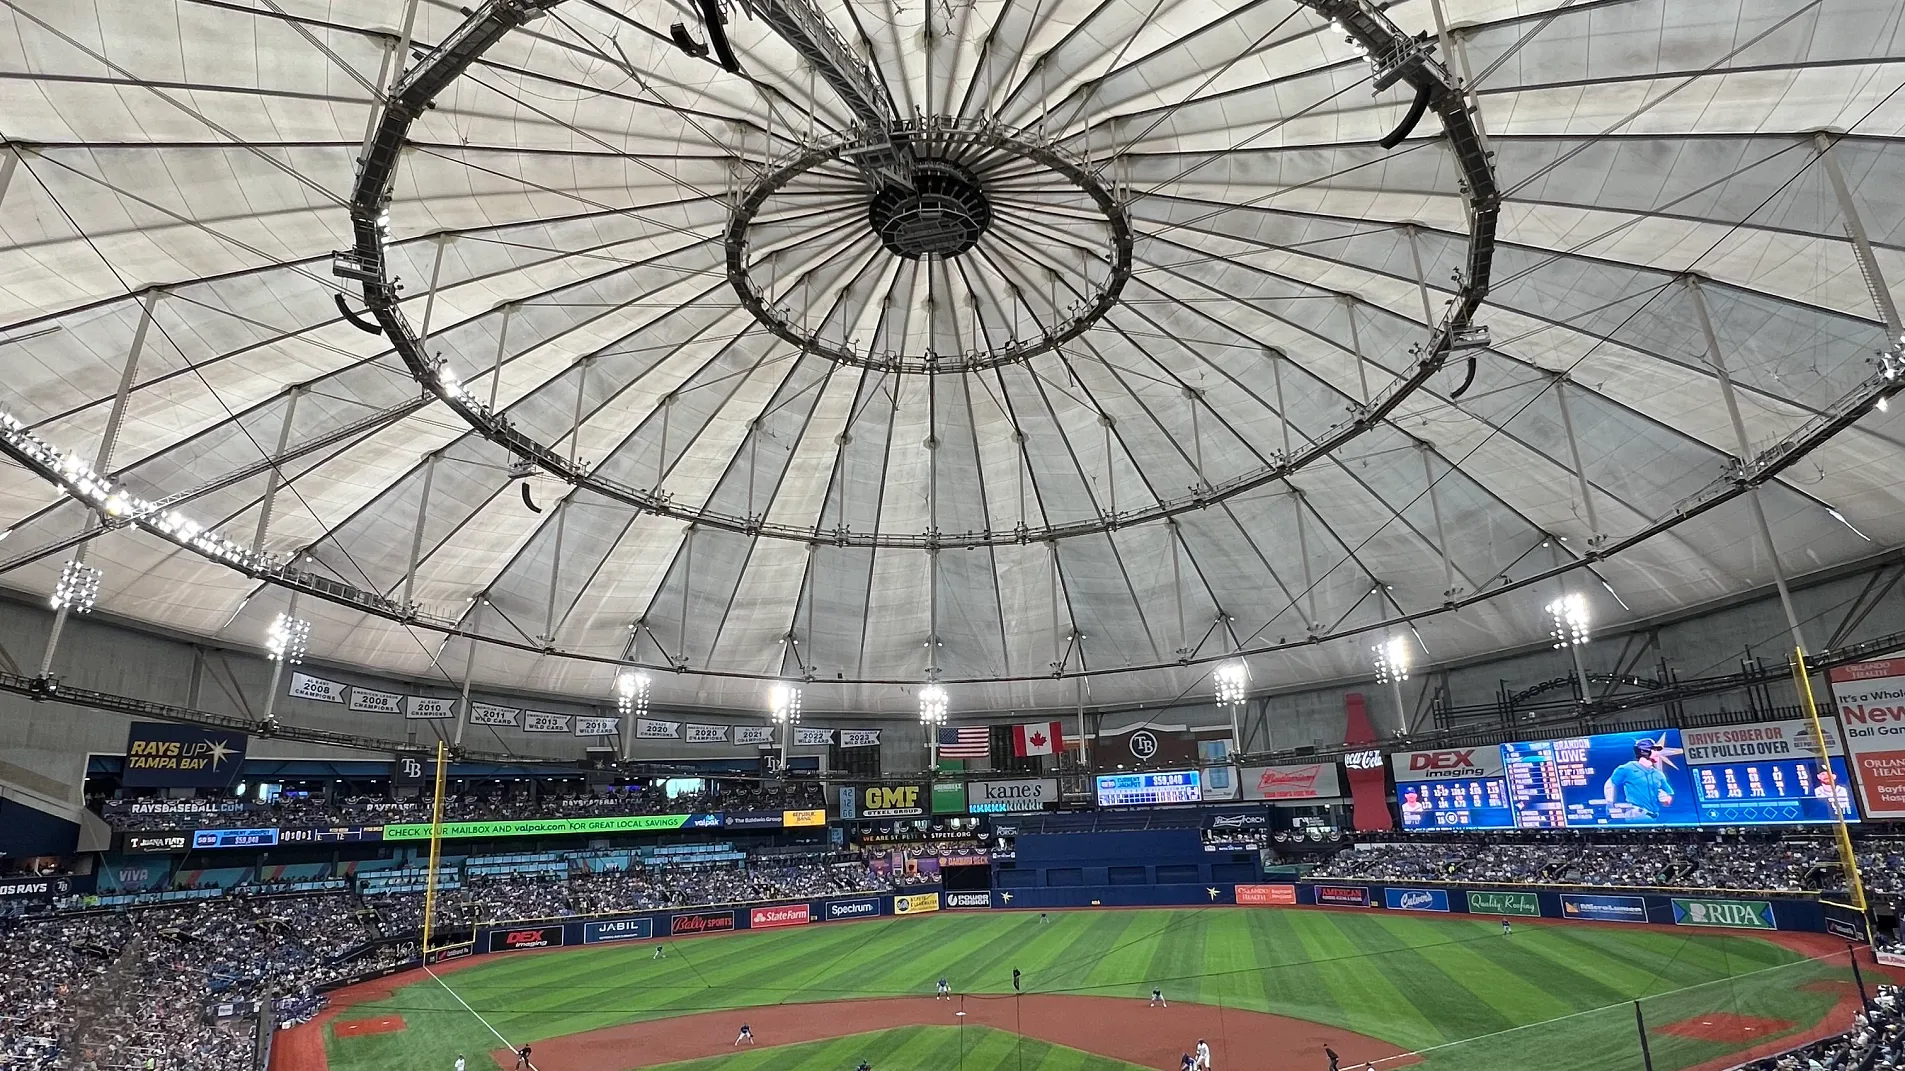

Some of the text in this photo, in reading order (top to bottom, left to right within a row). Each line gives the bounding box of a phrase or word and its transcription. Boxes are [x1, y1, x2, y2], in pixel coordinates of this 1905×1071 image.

[1845, 661, 1891, 673] ORLANDO
[295, 688, 336, 702] CHAMPIONS
[303, 682, 331, 695] 2008
[362, 695, 388, 706] 2008
[1839, 694, 1858, 704] It's
[1859, 694, 1869, 702] a
[353, 703, 394, 712] CHAMPIONS
[417, 703, 442, 712] 2010
[483, 711, 505, 719] 2011
[535, 718, 558, 726] 2013
[1688, 727, 1783, 746] DRIVE SOBER OR
[1848, 727, 1875, 738] Ball
[131, 741, 207, 757] RAYS UP
[1133, 735, 1154, 753] TB
[1553, 739, 1591, 751] BRANDON
[1688, 747, 1713, 760] GET
[1713, 743, 1756, 758] PULLED
[1757, 740, 1790, 755] OVER
[1409, 749, 1476, 771] DEX
[1555, 749, 1588, 763] LOWE
[129, 757, 208, 770] TAMPA BAY
[401, 758, 421, 778] TB
[1425, 767, 1485, 778] imaging
[842, 788, 853, 797] 42
[865, 785, 920, 809] GMF
[984, 782, 1042, 800] kane's
[131, 803, 244, 813] RAYSBASEBALL.COM
[843, 799, 852, 808] 12
[388, 828, 421, 838] CHECK
[451, 825, 491, 835] MAILBOX
[491, 825, 512, 833] AND
[515, 823, 566, 834] valpak.com
[569, 822, 586, 830] FOR
[588, 821, 614, 830] GREAT
[616, 819, 643, 829] LOCAL
[645, 818, 679, 827] SAVINGS
[694, 818, 720, 828] valpak
[931, 831, 971, 839] STPETE.ORG
[119, 868, 149, 883] VIVA
[17, 883, 47, 894] RAYS
[1471, 893, 1535, 912] Quality Roofing
[831, 903, 871, 916] Spectrum
[1708, 904, 1760, 925] RIPA
[599, 921, 639, 932] JABIL
[673, 915, 733, 932] Bally SPORTS
[507, 930, 545, 944] DEX
[515, 940, 548, 948] imaging
